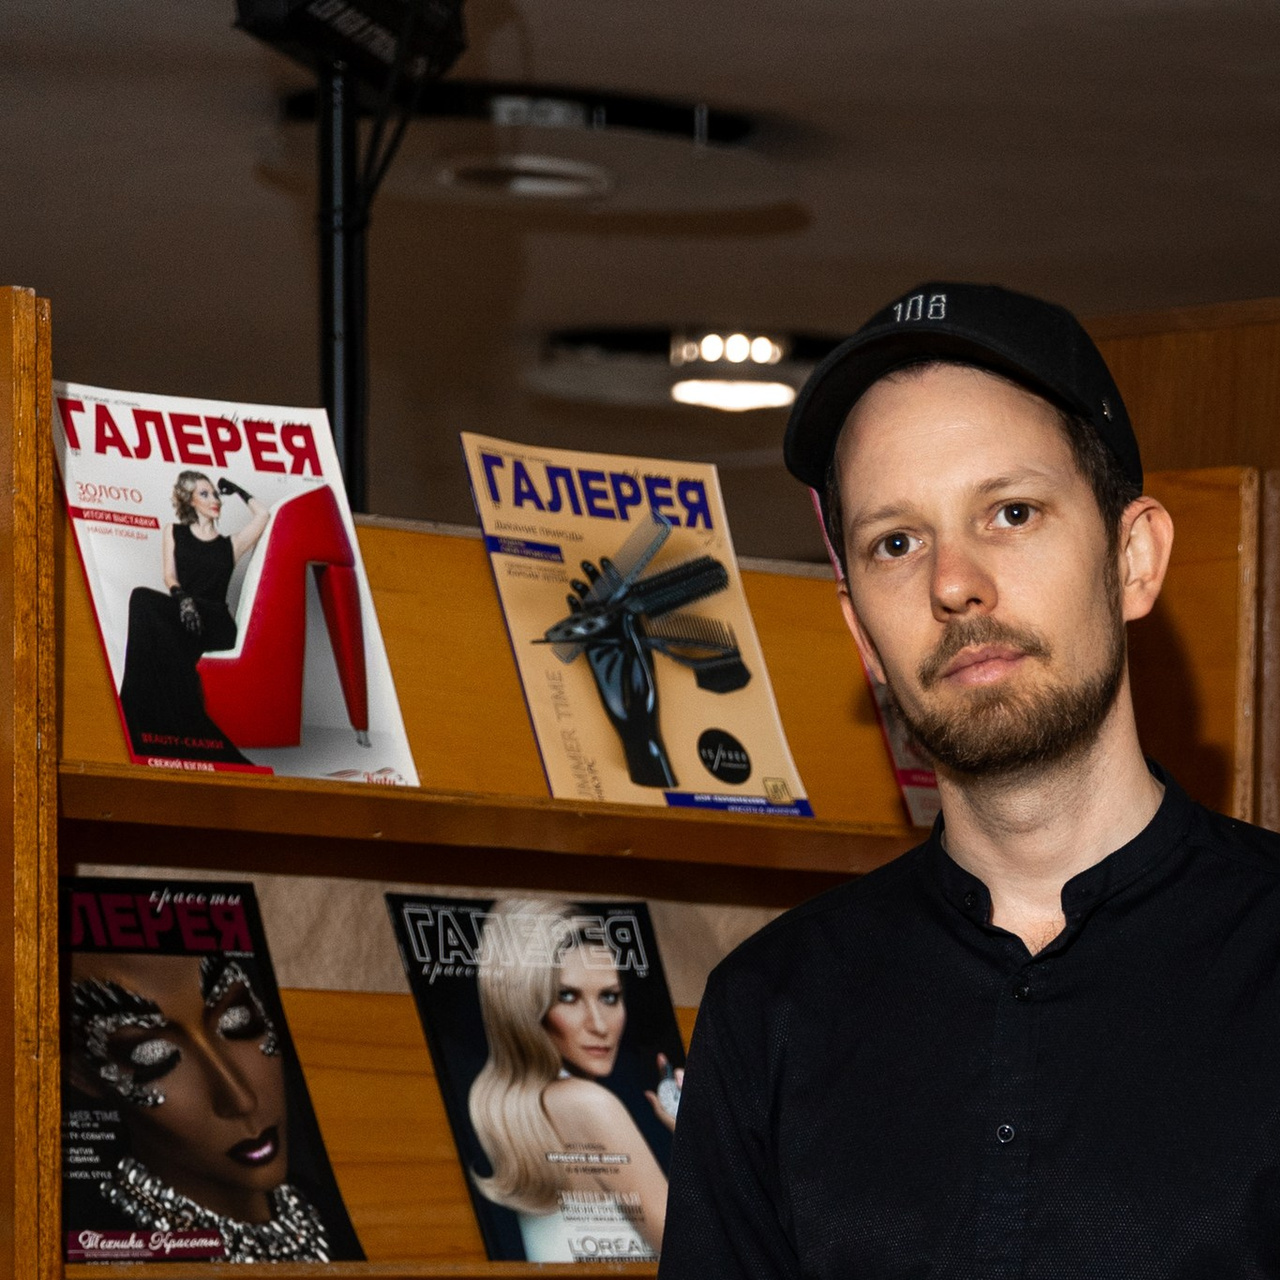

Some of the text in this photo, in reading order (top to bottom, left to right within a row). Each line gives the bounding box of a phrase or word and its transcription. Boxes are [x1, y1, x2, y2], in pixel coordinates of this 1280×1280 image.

[57, 398, 324, 478] ГАЛЕРЕЯ
[76, 481, 143, 504] ЗОЛОТО
[481, 453, 713, 531] ГАЛЕРЕЯ
[68, 891, 255, 952] ЛЕРЕЯ
[403, 907, 649, 971] ГАЛЕРЕЯ
[77, 1229, 222, 1255] Техника Красоты
